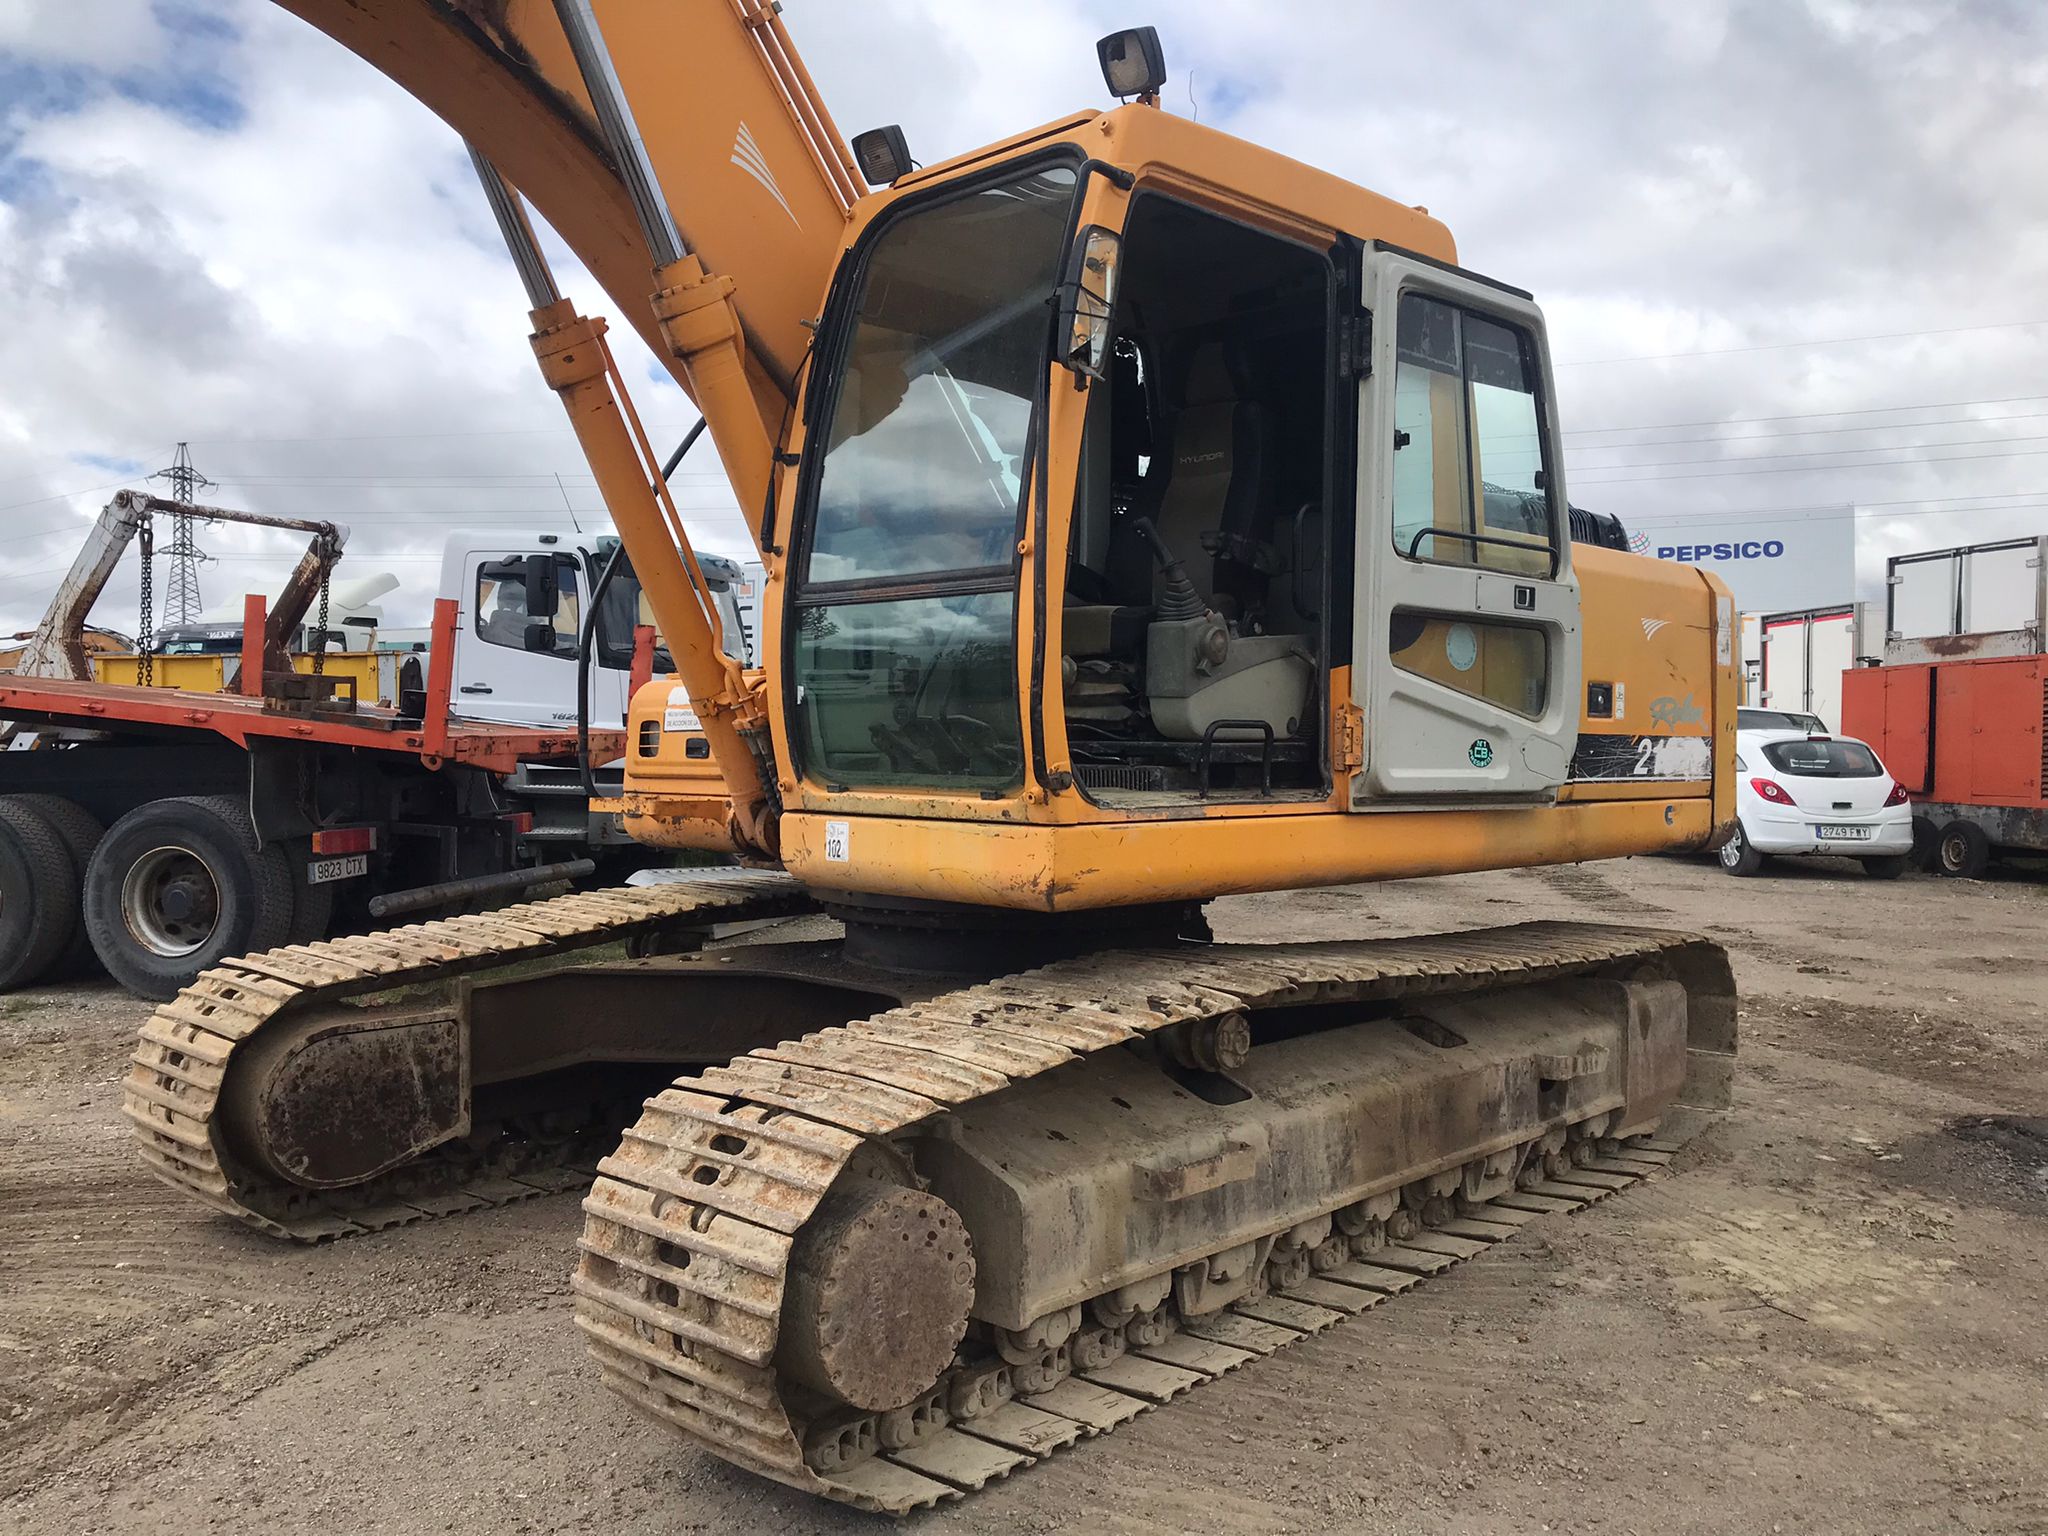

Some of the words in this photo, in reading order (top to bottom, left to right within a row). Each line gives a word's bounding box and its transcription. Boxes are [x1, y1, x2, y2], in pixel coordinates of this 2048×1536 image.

[1657, 540, 1785, 562] PEPSICO
[1823, 827, 1847, 837] 2749
[317, 862, 341, 880] 9823
[346, 857, 363, 875] CTX
